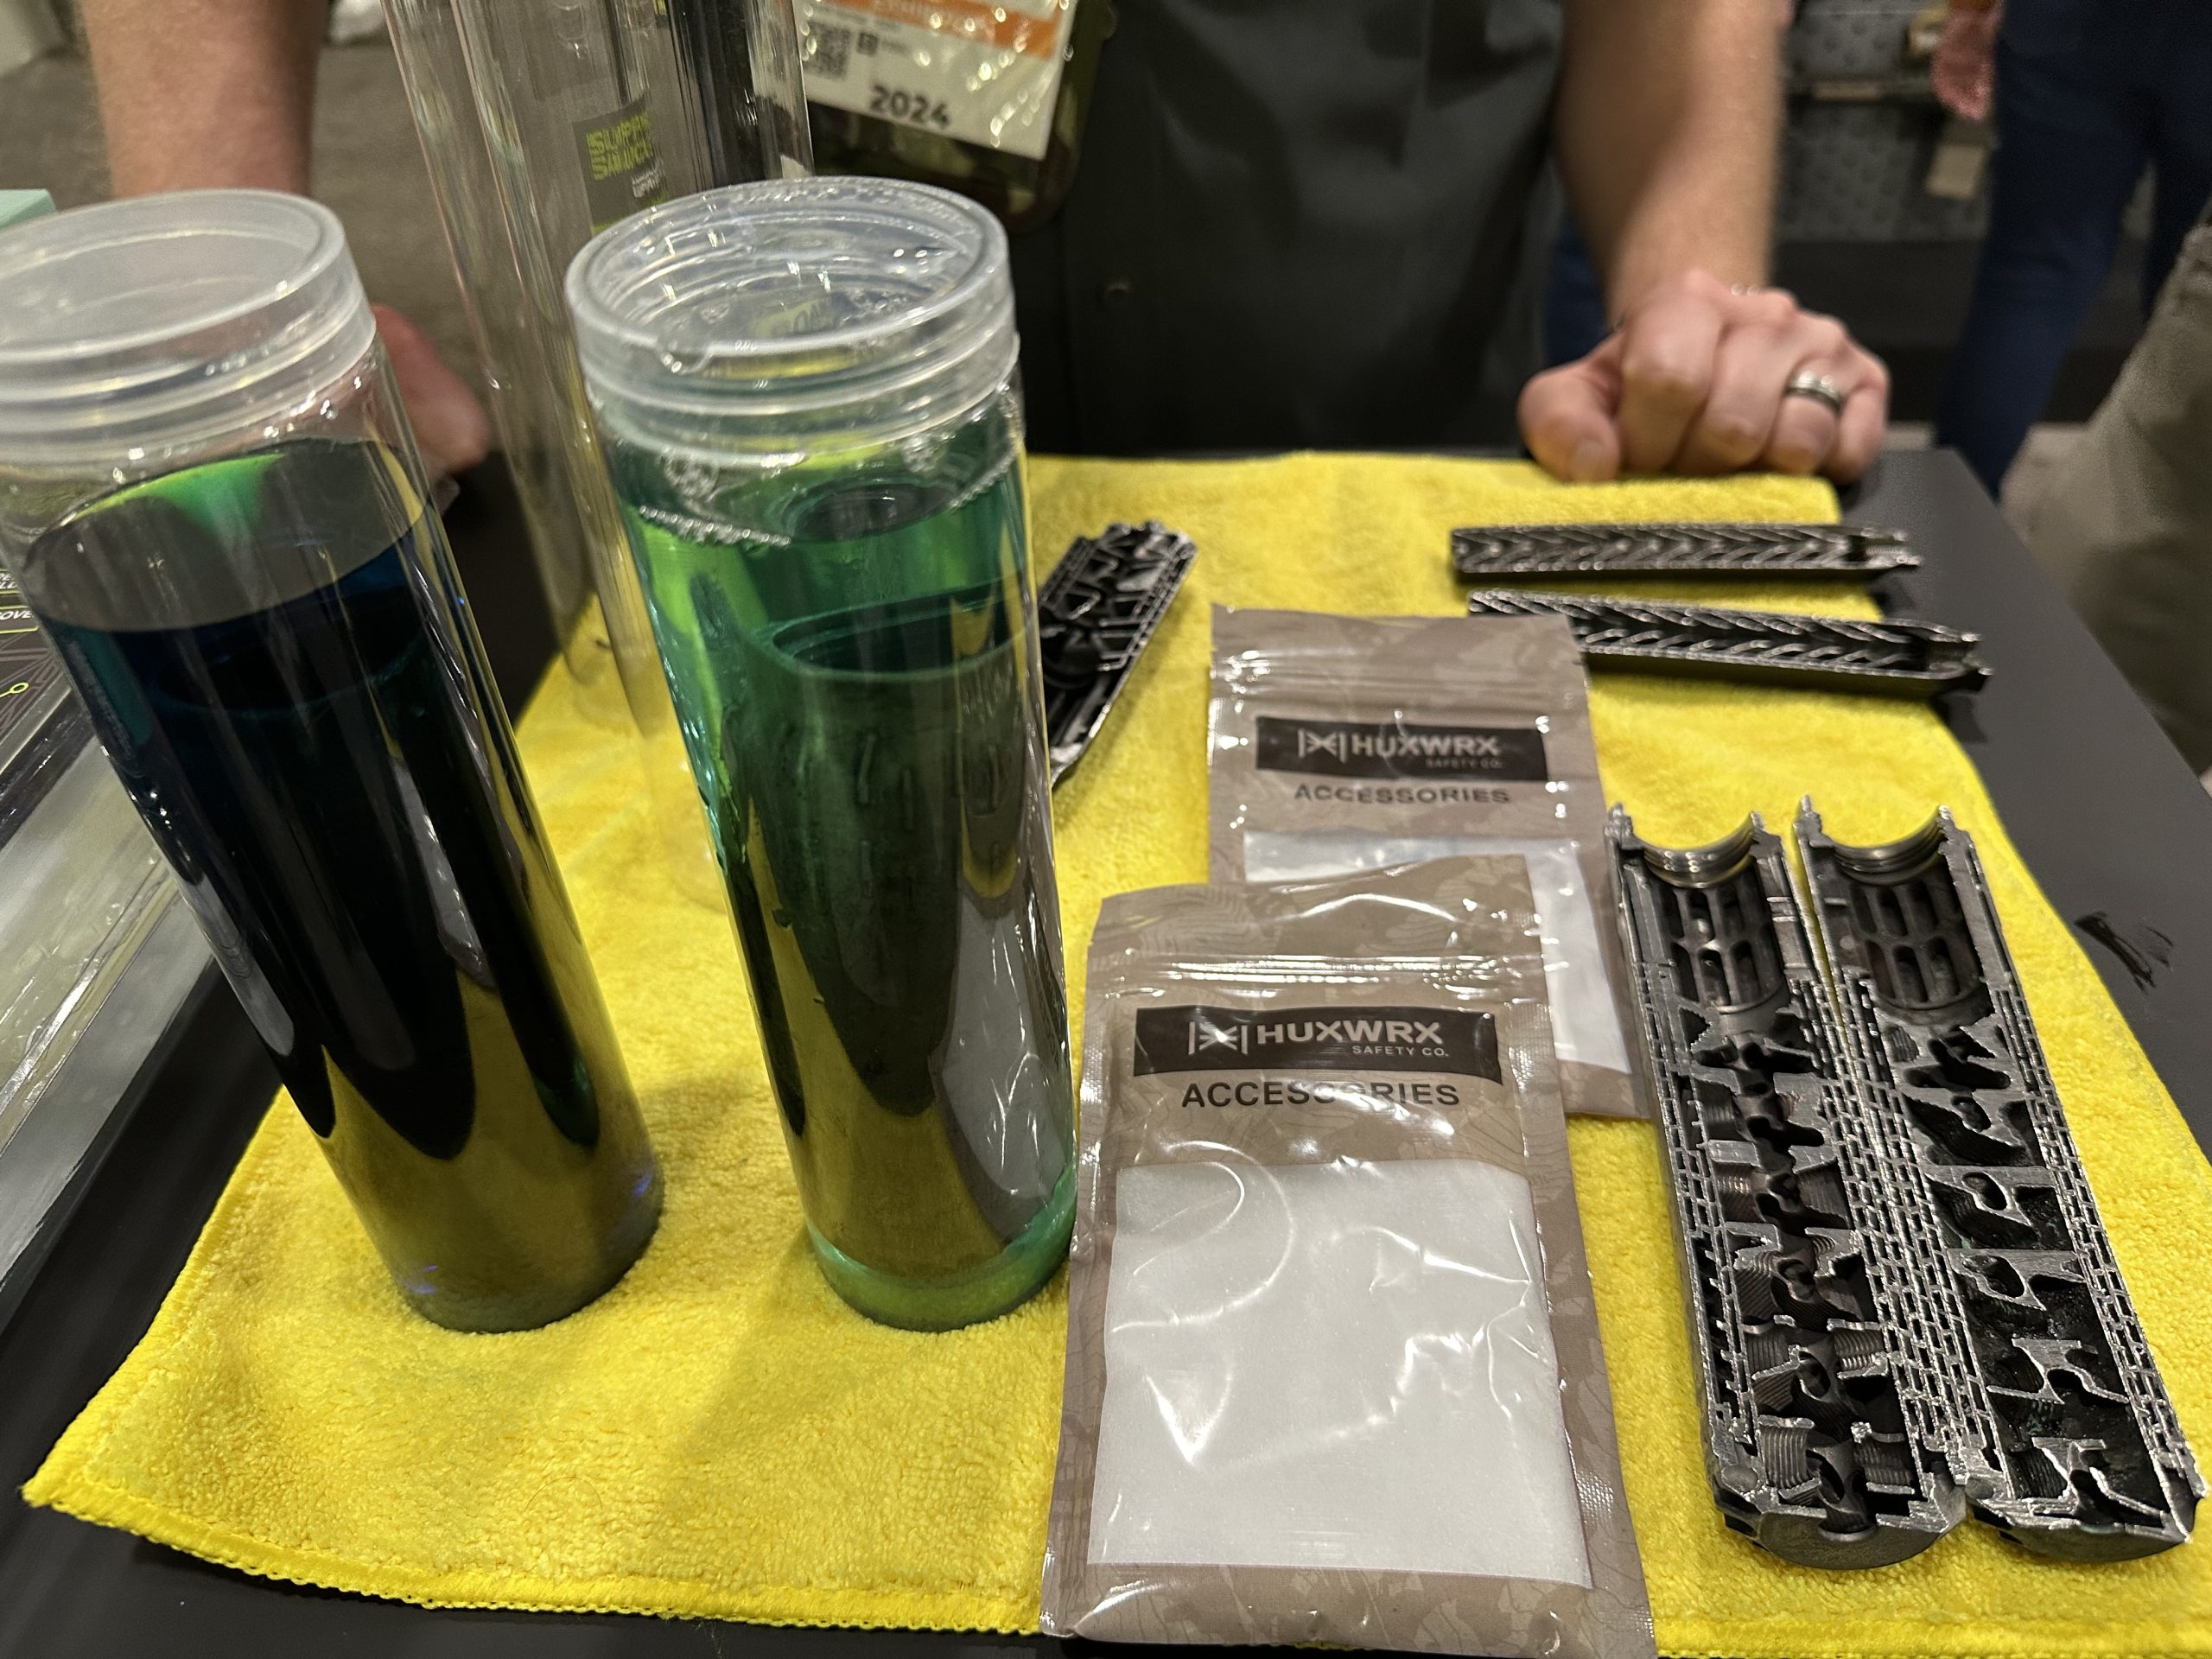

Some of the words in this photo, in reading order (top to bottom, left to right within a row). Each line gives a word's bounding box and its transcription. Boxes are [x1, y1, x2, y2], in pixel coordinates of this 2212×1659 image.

[870, 85, 950, 129] 2024
[1351, 734, 1500, 757] HUXWRX
[1294, 784, 1510, 804] ACCESSORIES
[1257, 1020, 1443, 1045] HUXWRX
[1351, 1045, 1415, 1056] SAFETY
[1421, 1046, 1450, 1057] CO.
[1181, 1082, 1460, 1108] ACCESSORIES
